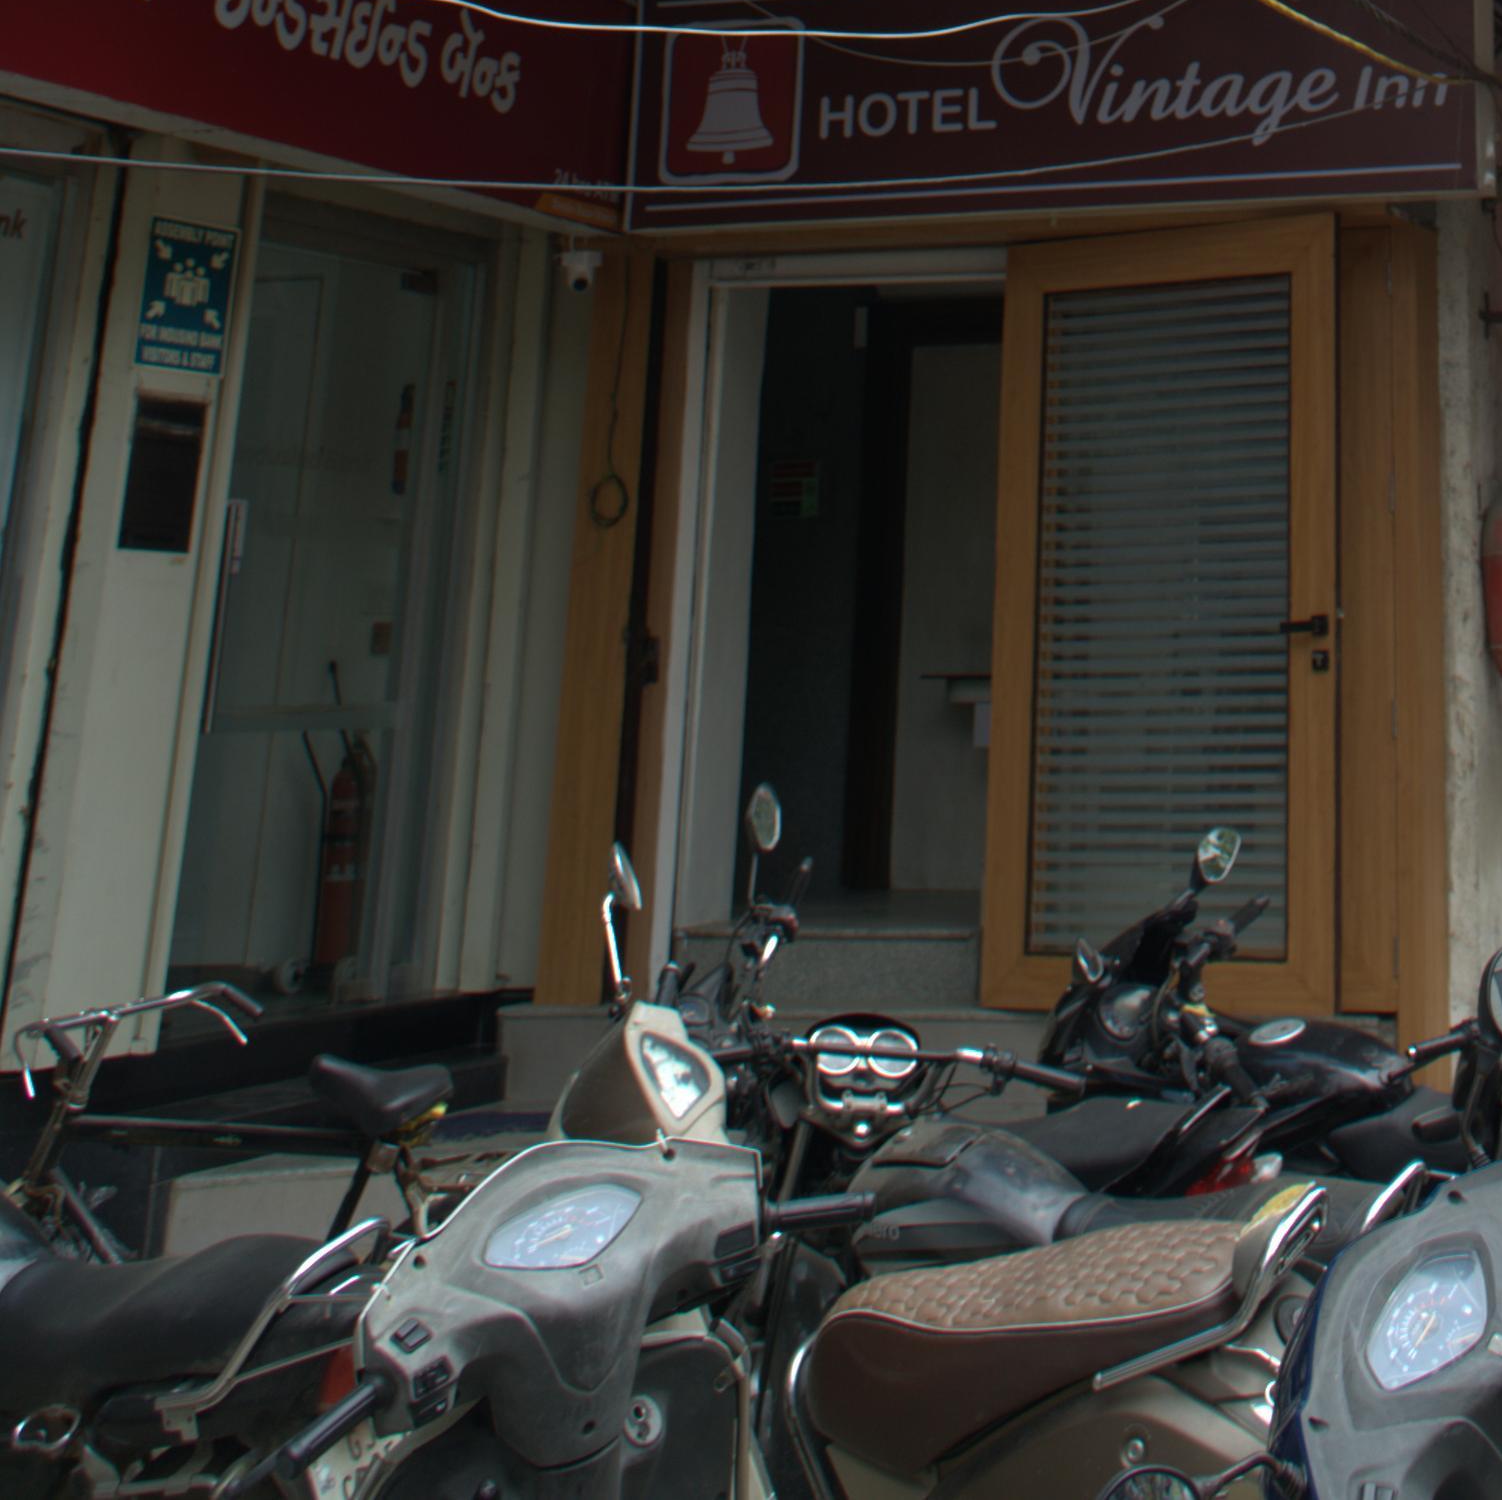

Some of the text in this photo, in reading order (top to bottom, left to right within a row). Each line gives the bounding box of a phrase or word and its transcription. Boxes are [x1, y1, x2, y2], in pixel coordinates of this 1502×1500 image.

[818, 16, 1449, 147] HOTEL Vintage Inn
